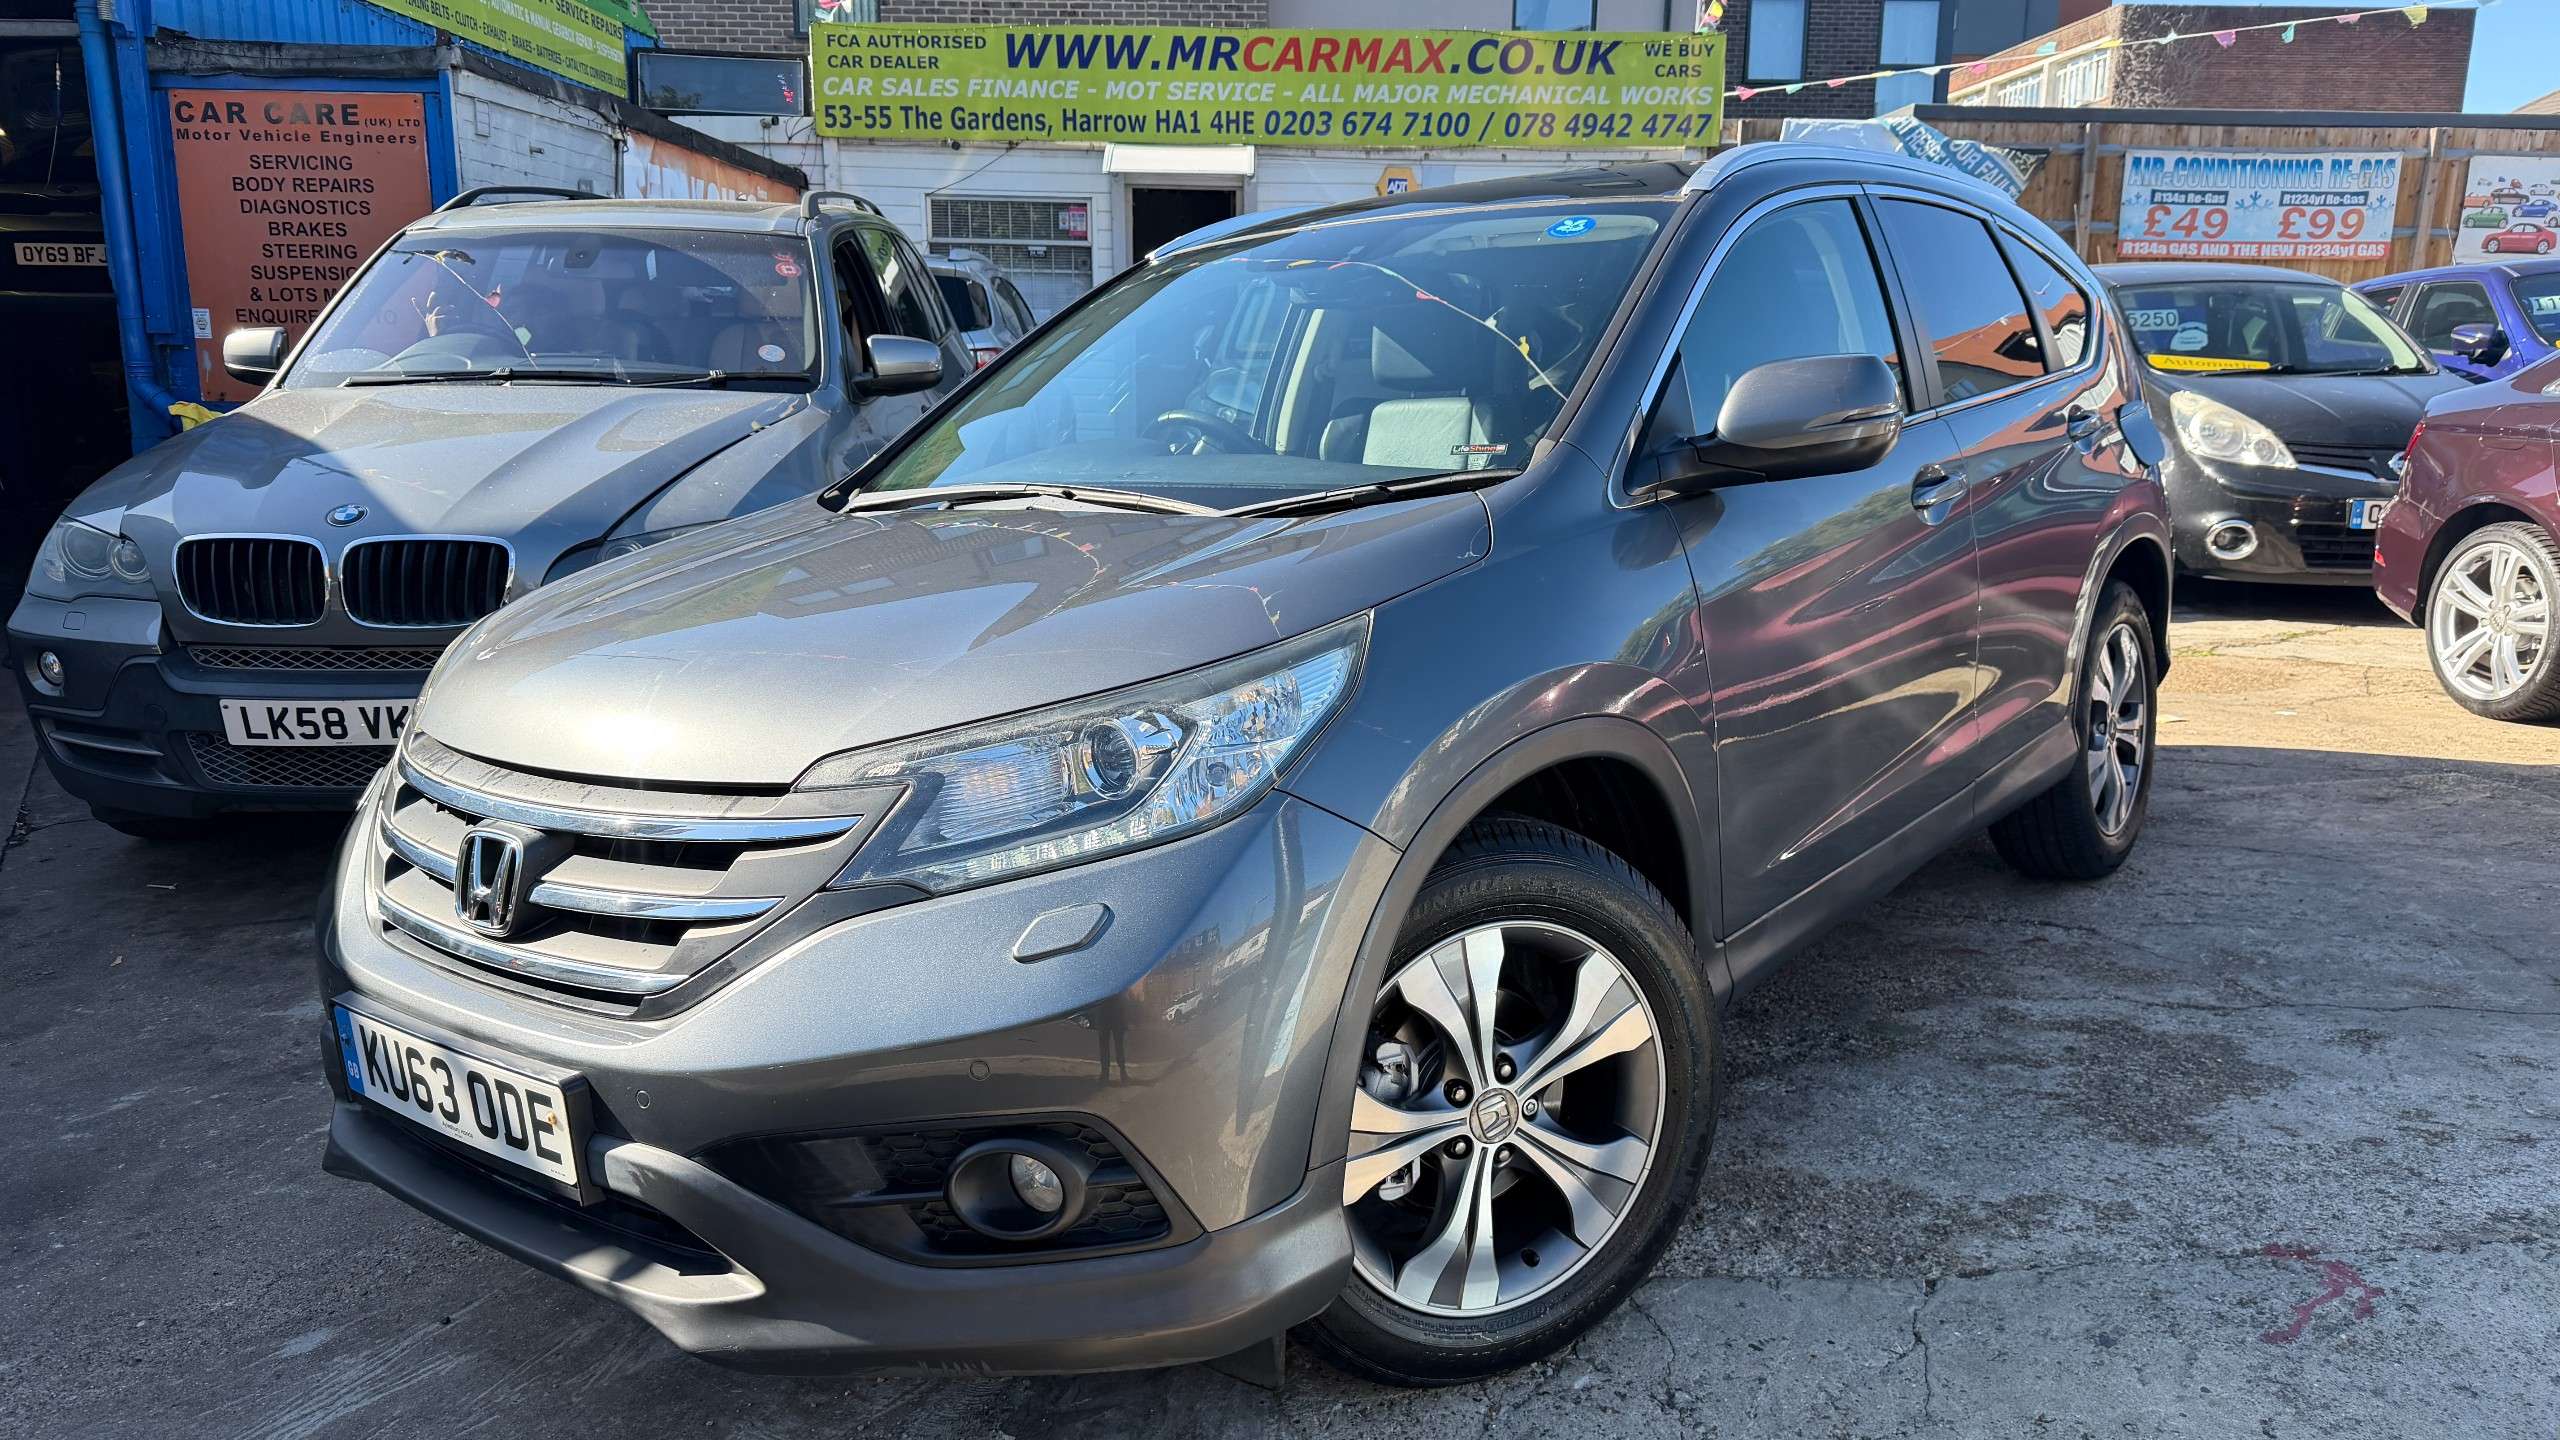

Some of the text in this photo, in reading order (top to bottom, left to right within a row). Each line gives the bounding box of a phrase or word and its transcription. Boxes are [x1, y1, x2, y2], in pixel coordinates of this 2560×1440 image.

[556, 0, 589, 25] SERVICE
[591, 14, 623, 40] REPAIRS
[431, 1, 450, 20] BELTS
[455, 10, 478, 30] CLUTCH
[483, 22, 507, 42] EXHAUST
[511, 34, 533, 53] BRAKES
[536, 44, 562, 65] BATTERIES
[827, 34, 987, 49] FCA AUTHORISED
[1005, 33, 1622, 75] WWW.MRCARMAX.CO.UK
[1645, 43, 1714, 57] WE BUY
[827, 55, 939, 69] CAR DEALER
[1655, 64, 1702, 78] CARS
[823, 77, 873, 97] CAR
[881, 77, 959, 97] SALES
[967, 79, 1080, 99] FINANCE
[1105, 80, 1162, 100] MOT
[1167, 82, 1276, 101] SERVICE
[1300, 83, 1344, 103] ALL
[1353, 84, 1440, 104] MAJOR
[1446, 85, 1611, 105] MECHANICAL
[1620, 86, 1714, 105] WORKS
[174, 101, 421, 129] CAR CARE (UK) LTD
[824, 105, 1713, 142] 53-55 The Gardens, Harrow HA1 4HE 0203 674 7100 / 078 4942 4747
[176, 128, 417, 146] Motor Vehicle Engineers
[249, 155, 353, 171] SERVICING
[2128, 156, 2397, 189] AIR-CONDITIONING RE-GAS
[232, 177, 375, 193] BODY REPAIRS
[2153, 192, 2226, 204] R134a Re-Gas
[2326, 194, 2365, 204] Re-Gas
[240, 199, 371, 215] DIAGNOSTICS
[268, 222, 348, 237] BRAKES
[2143, 205, 2230, 239] £49
[2276, 206, 2365, 240] £99
[23, 246, 69, 262] OY69
[262, 243, 358, 259] STEERING
[2121, 242, 2386, 257] R134a GAS AND THE NEW R1234yf GAS
[250, 287, 263, 301] &
[268, 288, 318, 302] LOTS
[240, 706, 349, 740] LK58
[347, 1060, 360, 1079] GB
[358, 1024, 563, 1166] KU63 ODE
